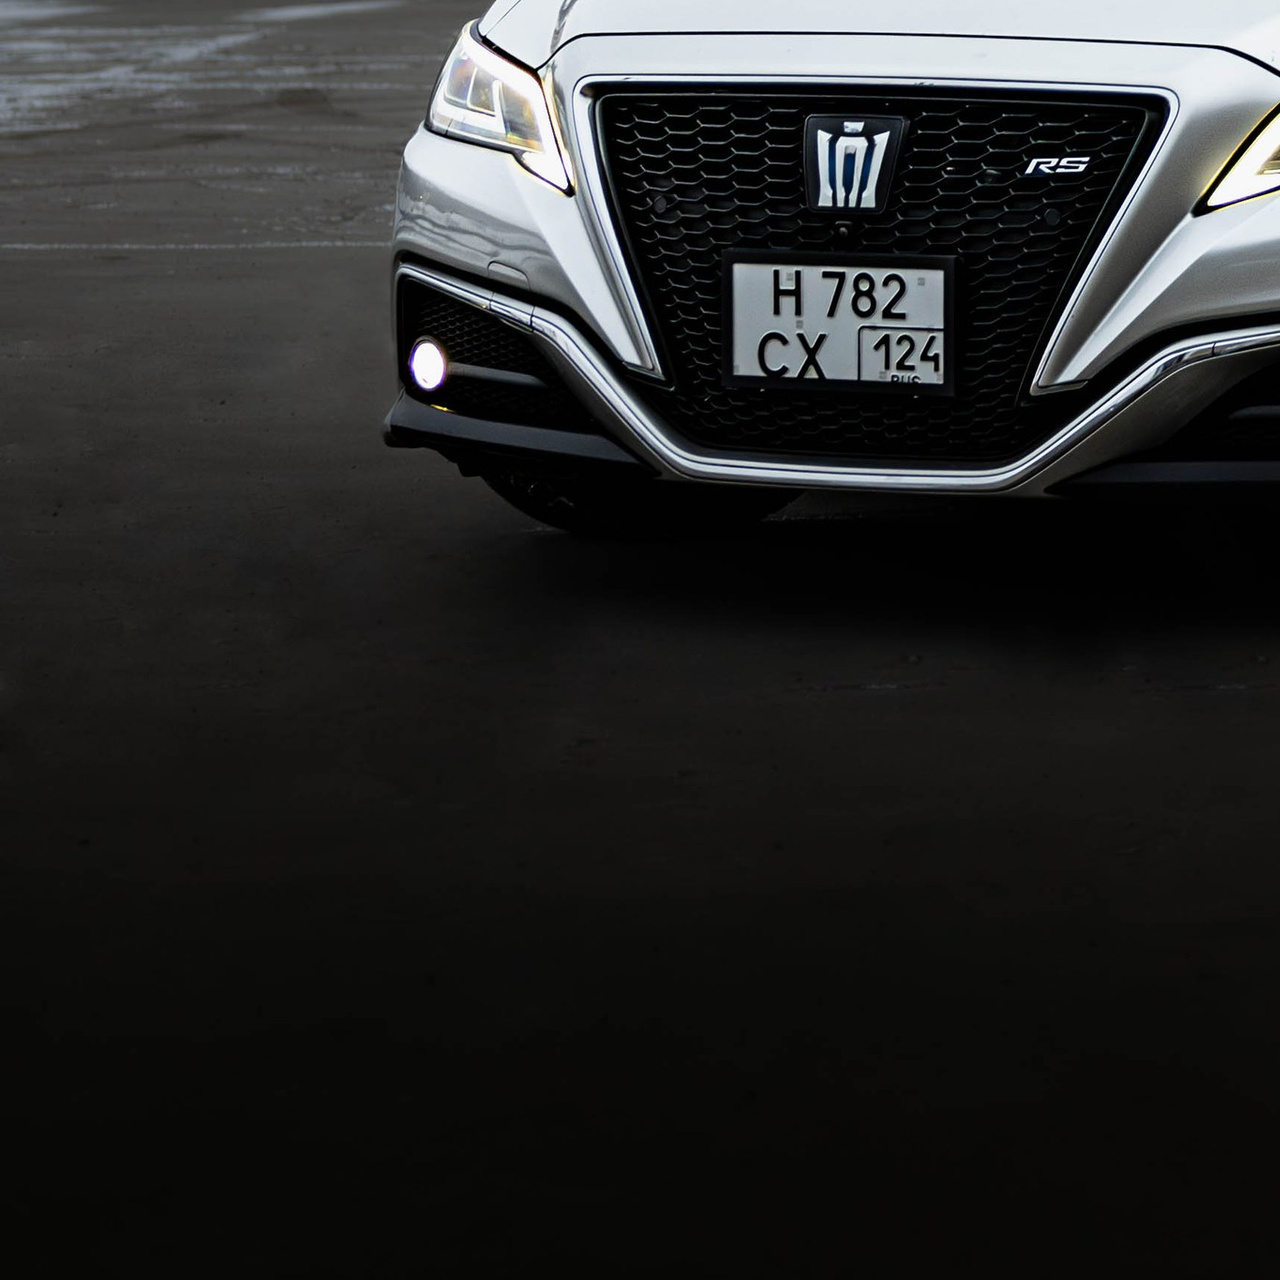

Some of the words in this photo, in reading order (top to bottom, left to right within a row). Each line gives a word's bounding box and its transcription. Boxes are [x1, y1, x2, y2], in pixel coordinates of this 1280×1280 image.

[1024, 156, 1091, 175] RS
[821, 270, 908, 320] 782
[872, 333, 941, 372] 124
